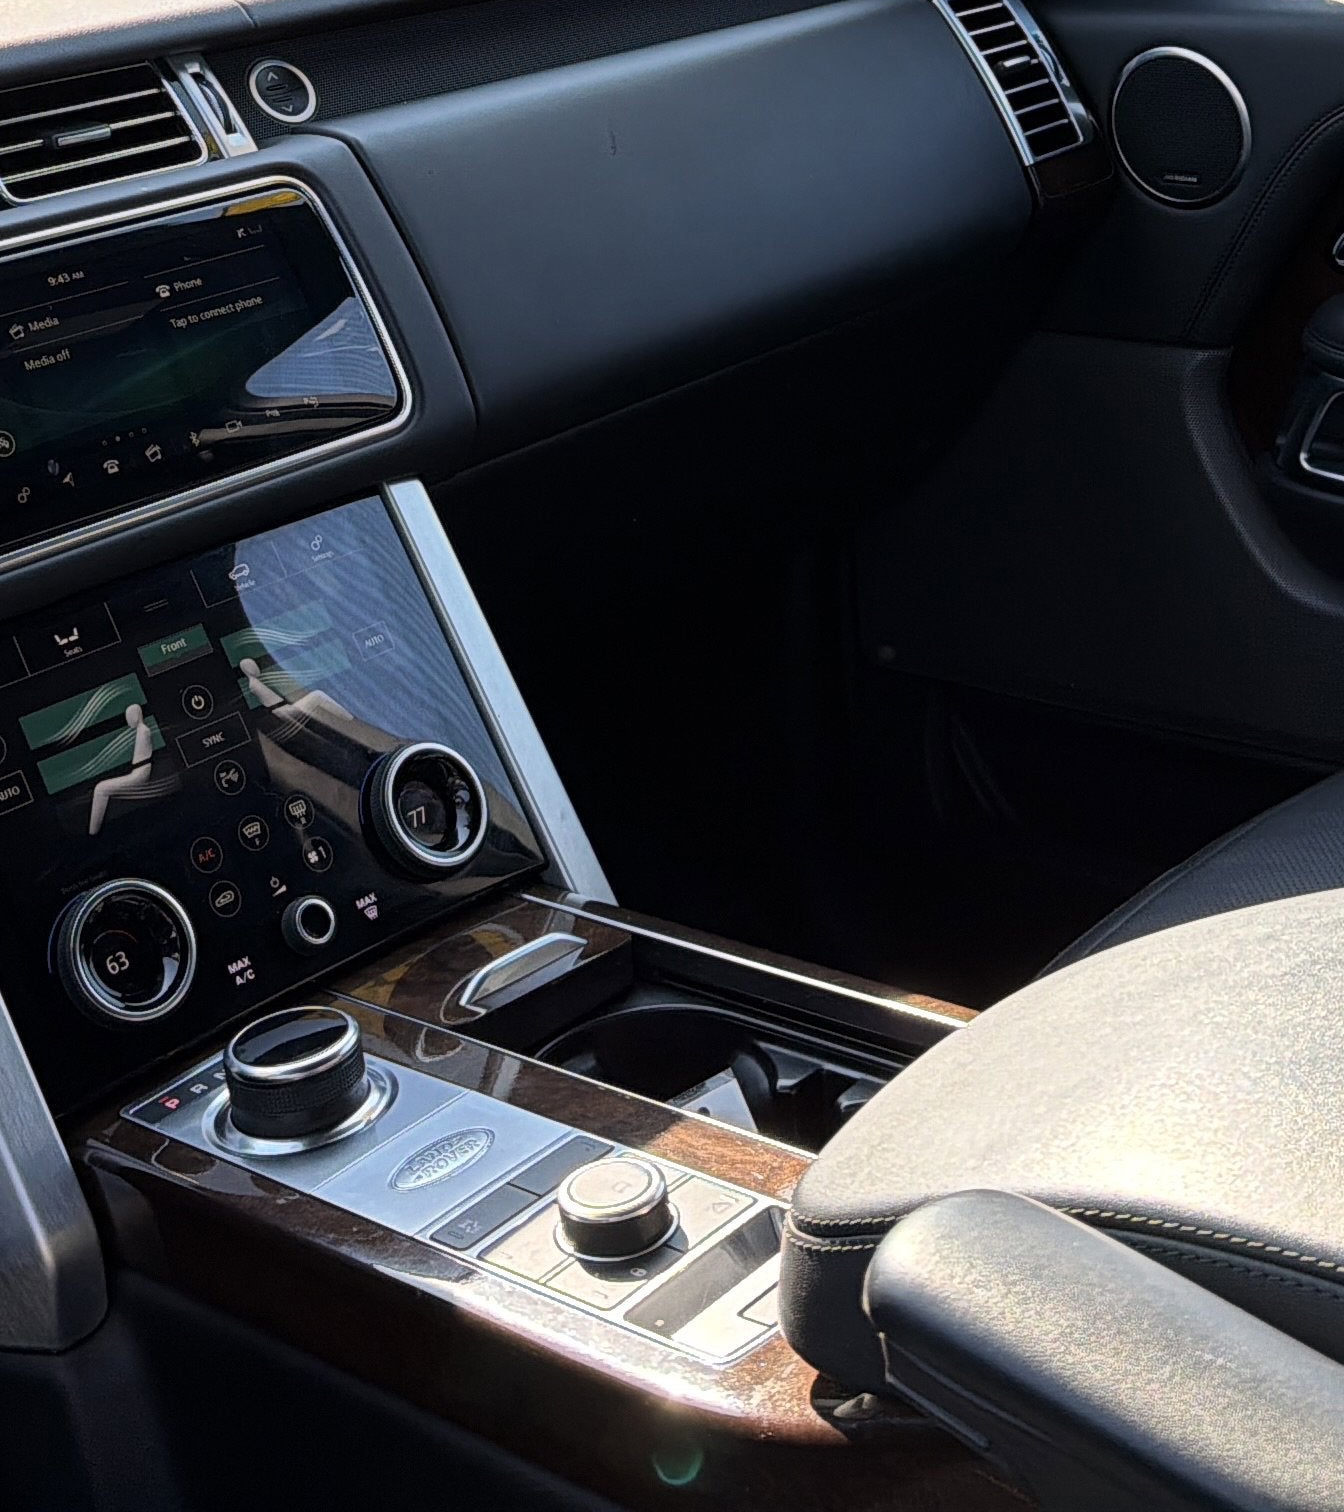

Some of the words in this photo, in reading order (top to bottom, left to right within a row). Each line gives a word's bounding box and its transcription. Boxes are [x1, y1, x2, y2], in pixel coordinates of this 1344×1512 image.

[47, 272, 70, 287] 9:43
[173, 277, 203, 292] Phone
[169, 316, 187, 329] Tap
[188, 314, 199, 324] to
[199, 303, 235, 322] connect
[234, 295, 264, 313] phone
[28, 316, 59, 332] Media
[23, 355, 55, 372] Media
[56, 348, 72, 363] off
[160, 637, 188, 655] Front
[364, 633, 385, 648] AUTO
[64, 645, 83, 658] Seats
[202, 731, 224, 749] SYNC
[407, 805, 427, 829] 77
[198, 847, 216, 864] A/C
[318, 845, 328, 859] 1
[356, 892, 378, 910] MAX
[106, 951, 129, 975] 63
[227, 955, 252, 975] MAX
[235, 969, 256, 986] A/C
[190, 1083, 208, 1094] R
